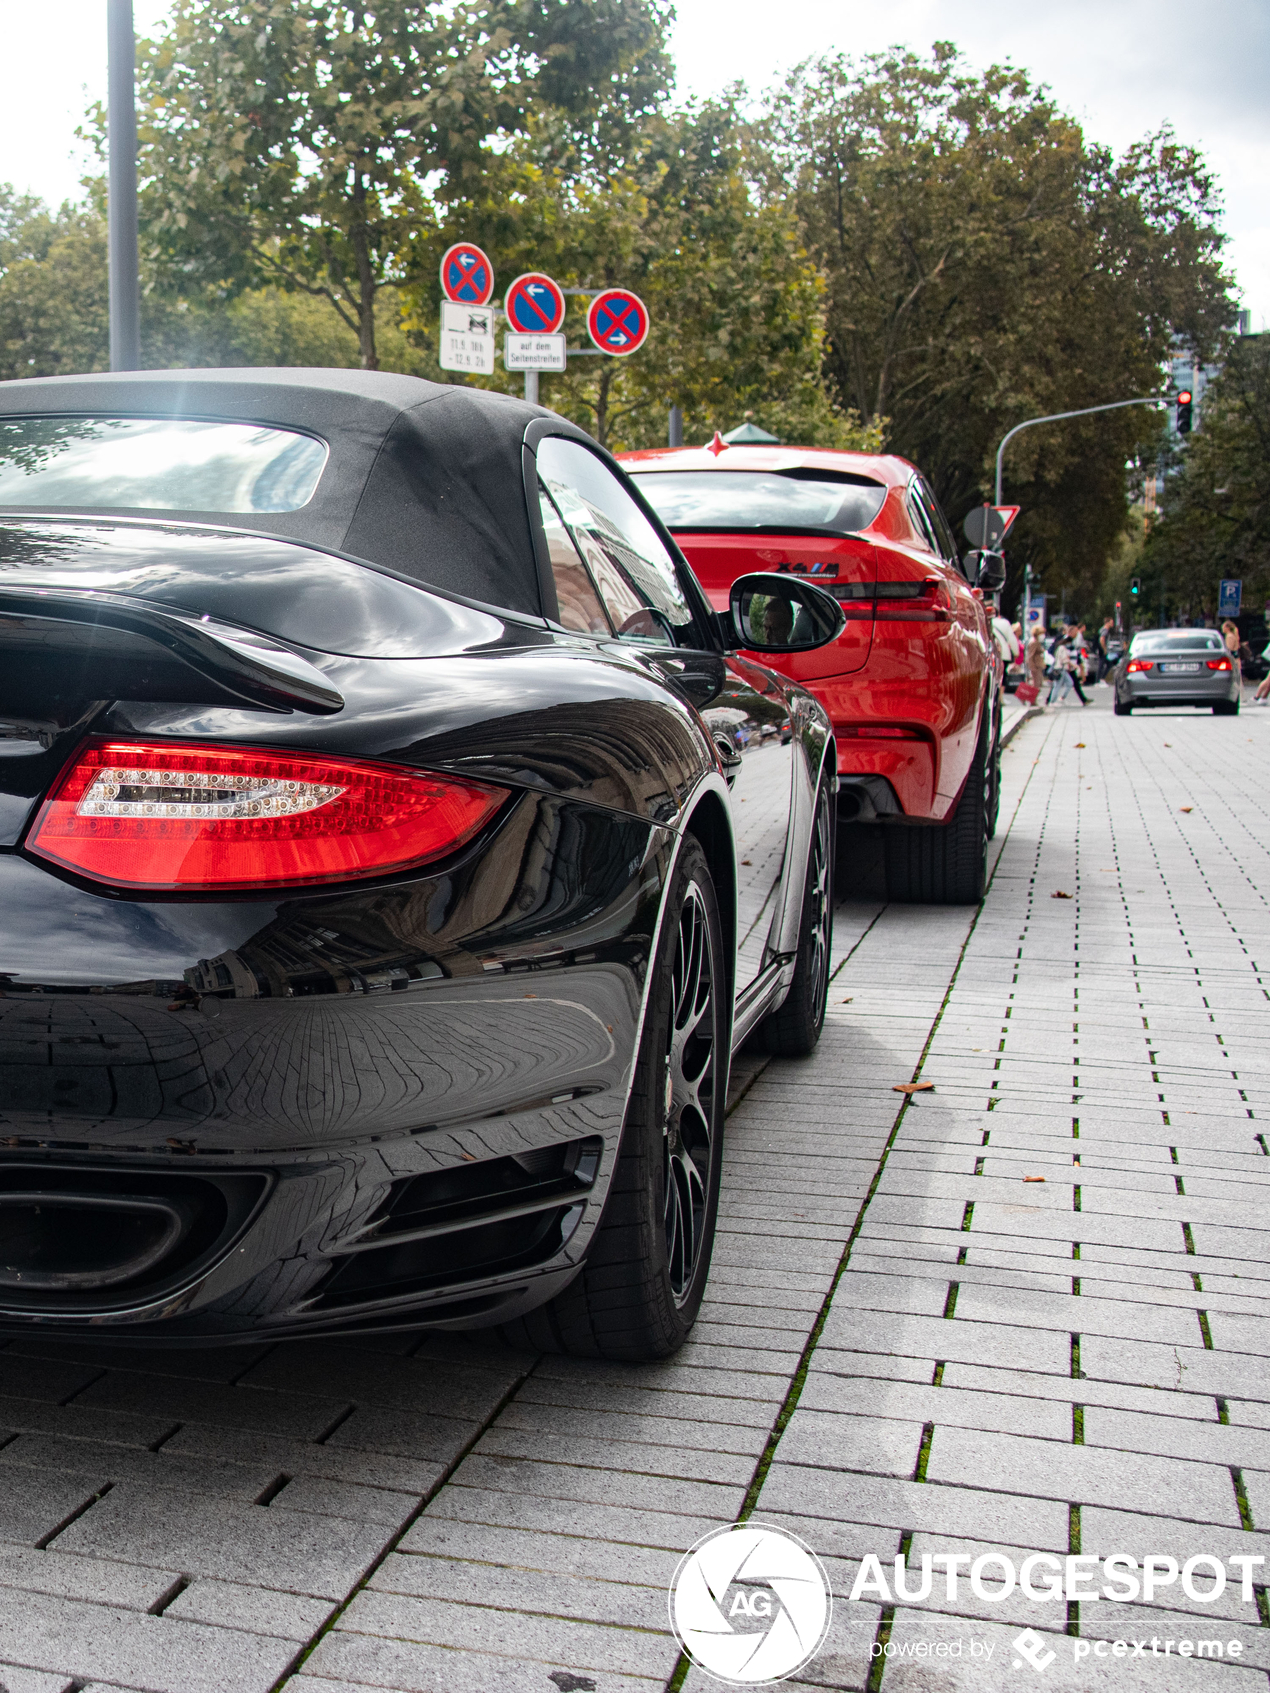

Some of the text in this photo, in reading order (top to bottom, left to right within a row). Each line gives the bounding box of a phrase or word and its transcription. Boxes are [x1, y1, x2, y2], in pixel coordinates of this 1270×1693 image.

[520, 341, 551, 350] auf dem
[511, 352, 560, 363] Seitenstreifen
[775, 562, 807, 573] X4
